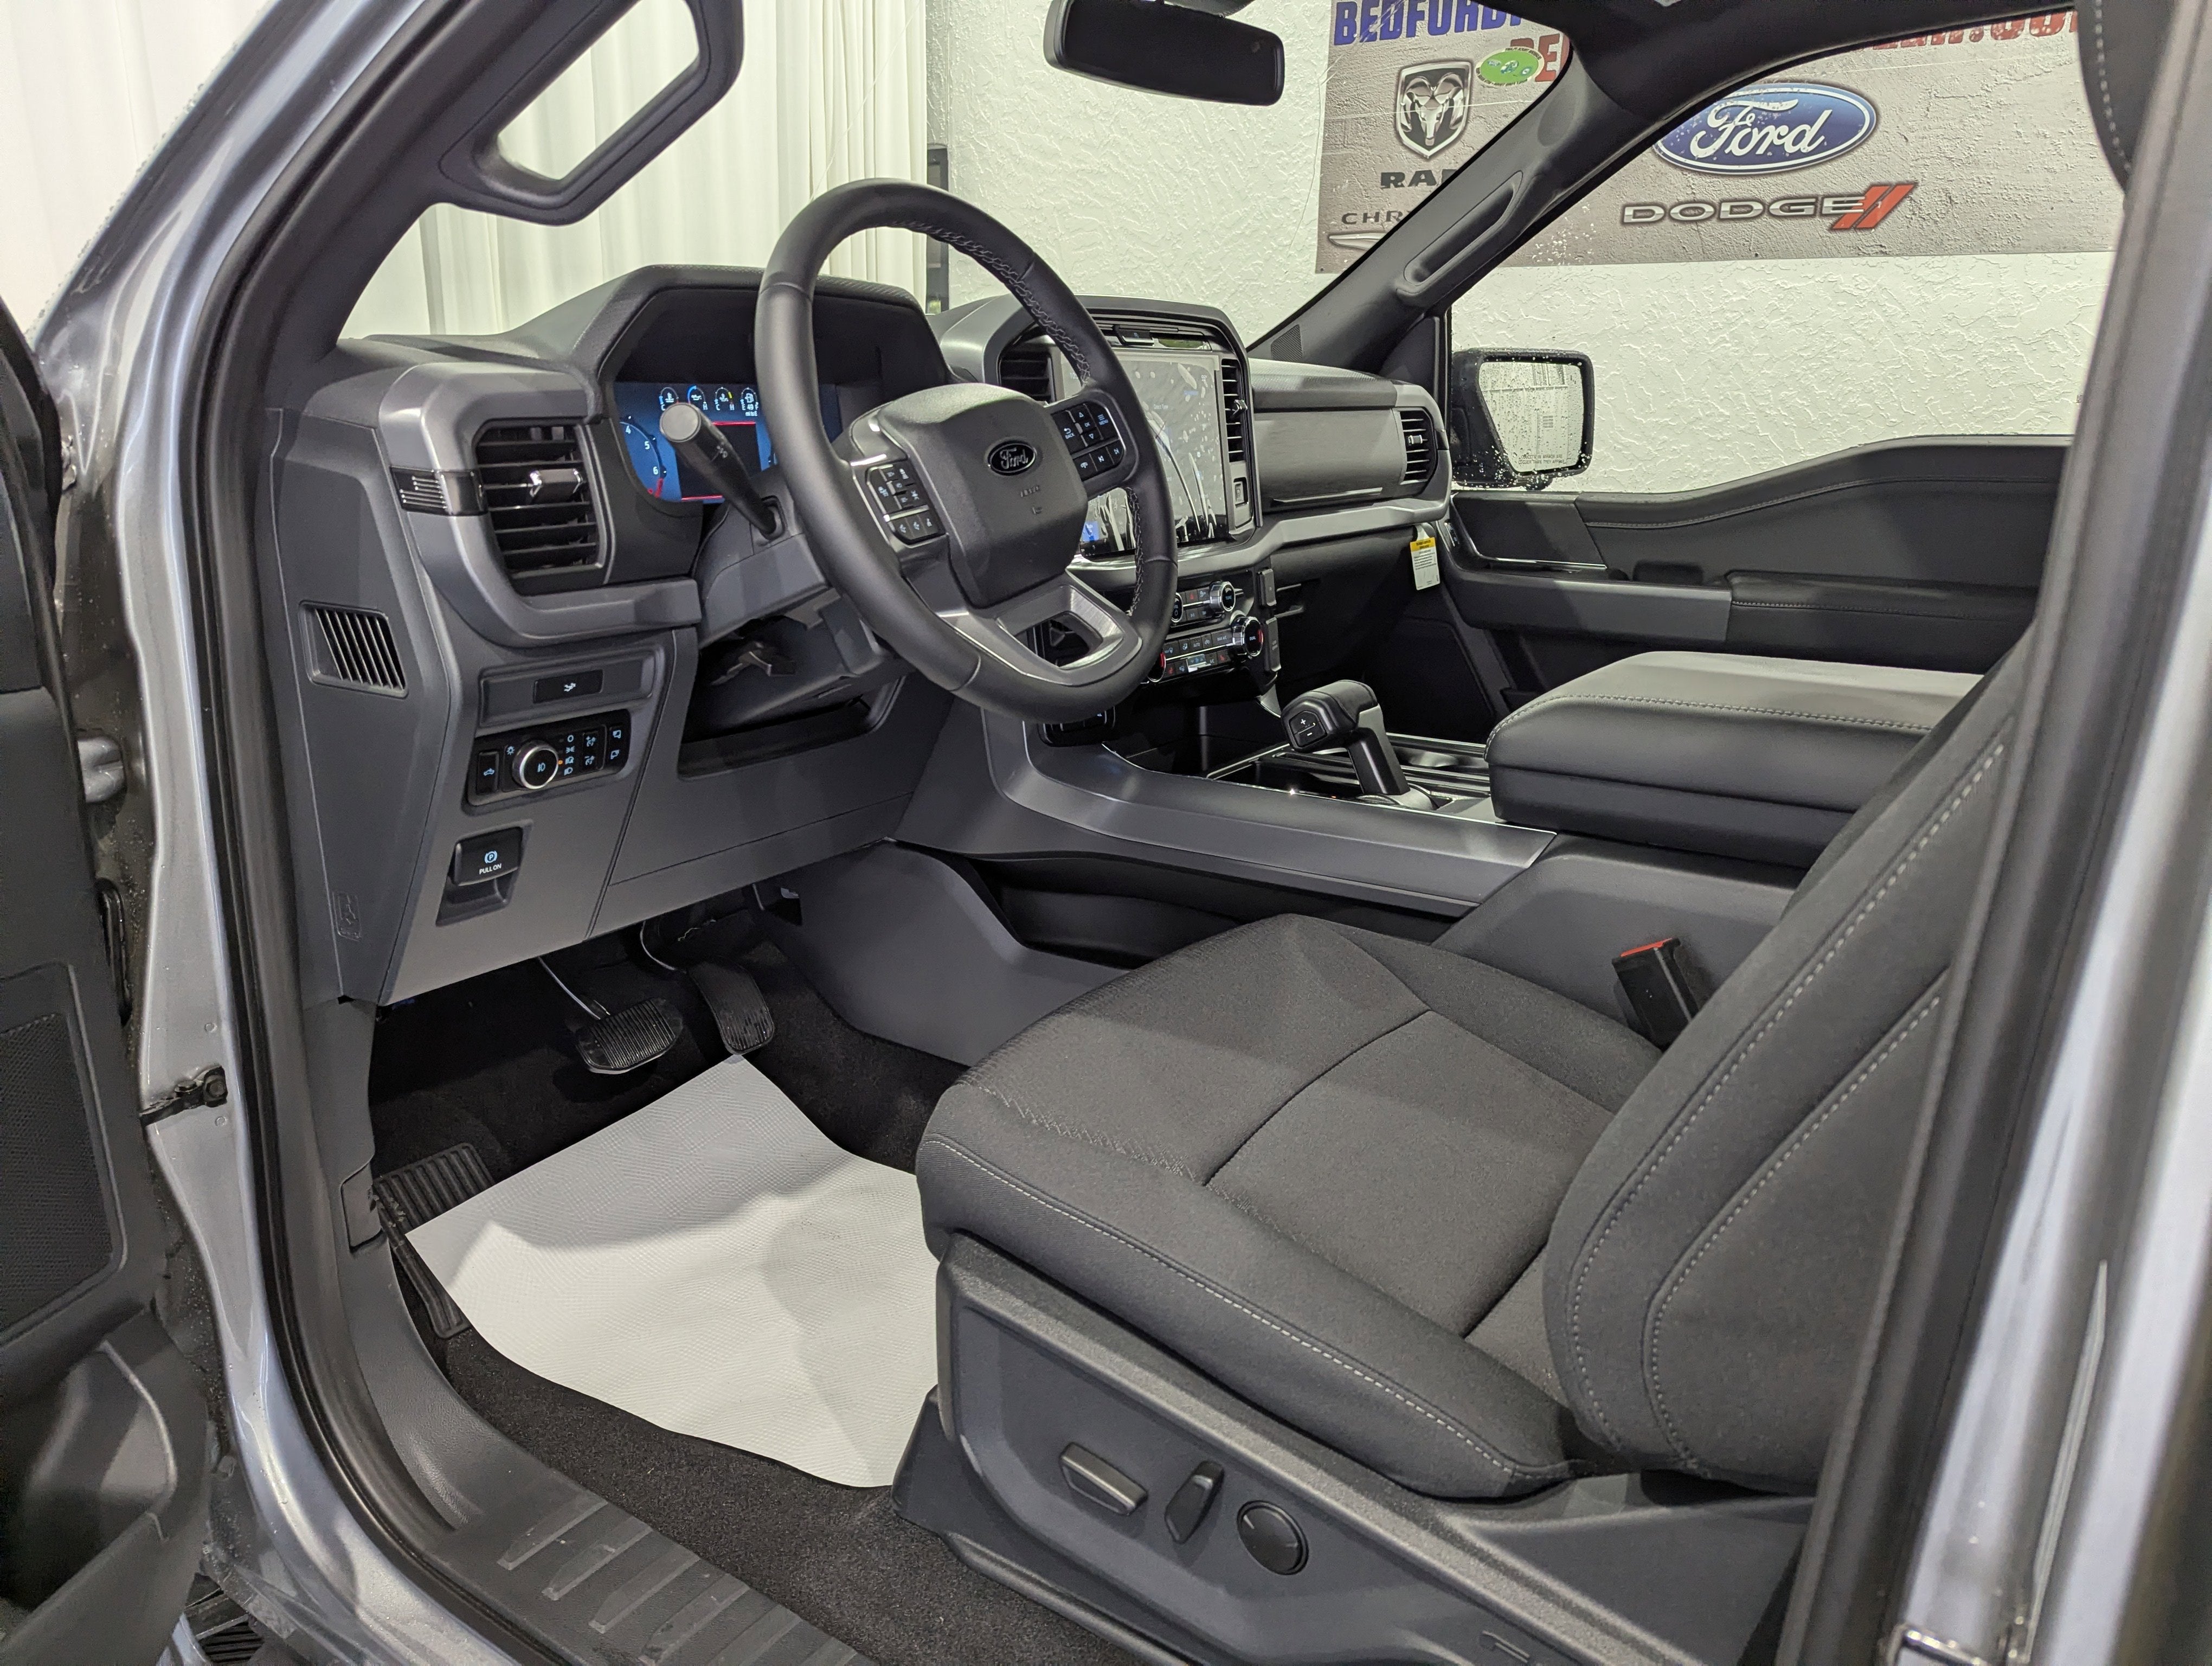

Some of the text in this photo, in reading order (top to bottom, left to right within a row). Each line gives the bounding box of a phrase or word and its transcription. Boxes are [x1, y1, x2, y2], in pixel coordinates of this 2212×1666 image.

[1334, 0, 1521, 46] BEDFORD
[1690, 99, 1832, 158] Ford
[1623, 196, 1866, 223] DODGE
[1341, 210, 1412, 225] CHR
[625, 425, 632, 434] 4
[644, 440, 650, 450] 5
[999, 447, 1028, 470] Ford
[652, 466, 659, 475] 6
[479, 866, 493, 875] PULL
